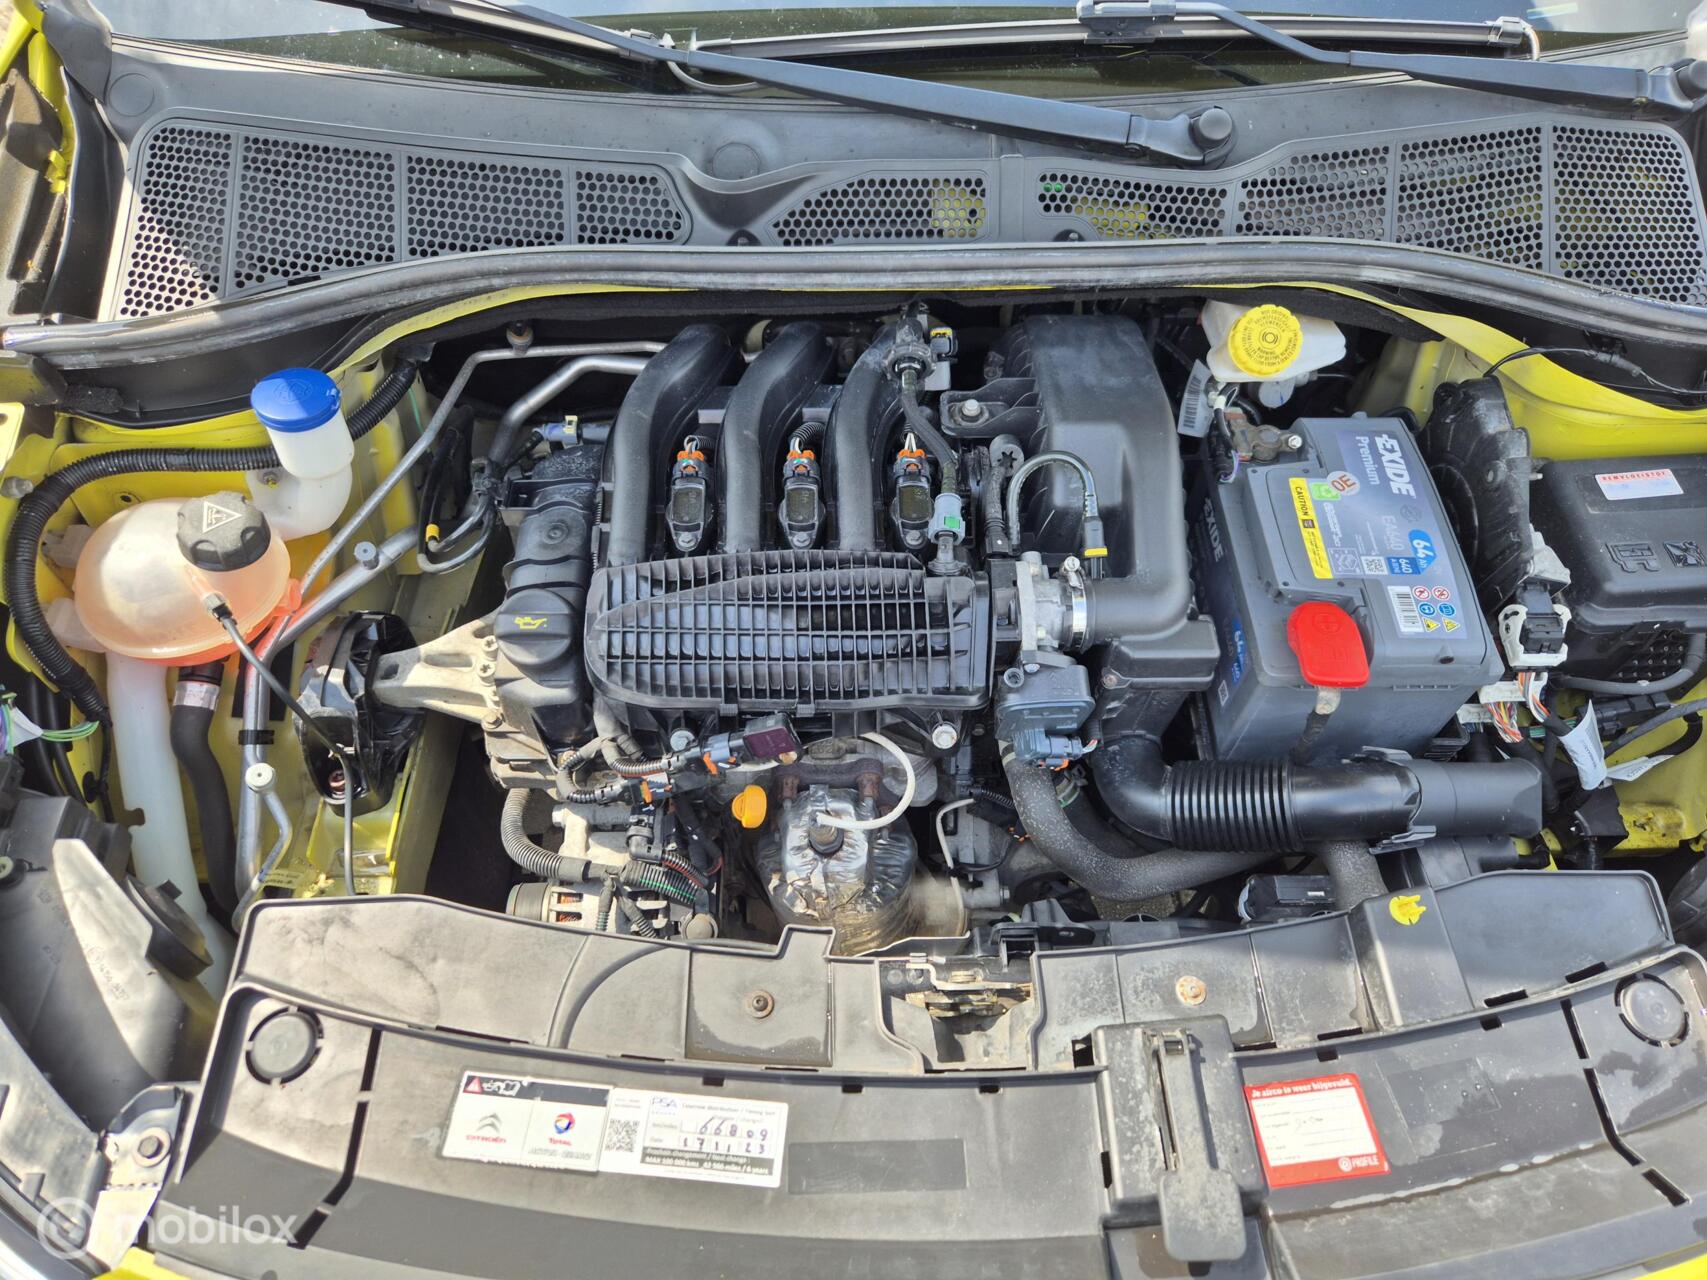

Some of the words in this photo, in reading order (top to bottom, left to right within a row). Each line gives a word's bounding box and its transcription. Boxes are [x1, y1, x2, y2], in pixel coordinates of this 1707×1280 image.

[1356, 436, 1380, 485] Premium
[1375, 434, 1416, 499] EXIDE
[1332, 474, 1357, 492] OE
[1294, 486, 1309, 516] CAUTION
[1203, 497, 1224, 563] EXIDE
[1412, 539, 1434, 558] 64
[1398, 558, 1413, 574] 640
[1252, 1089, 1261, 1098] Je
[1352, 1155, 1380, 1169] PROFILE
